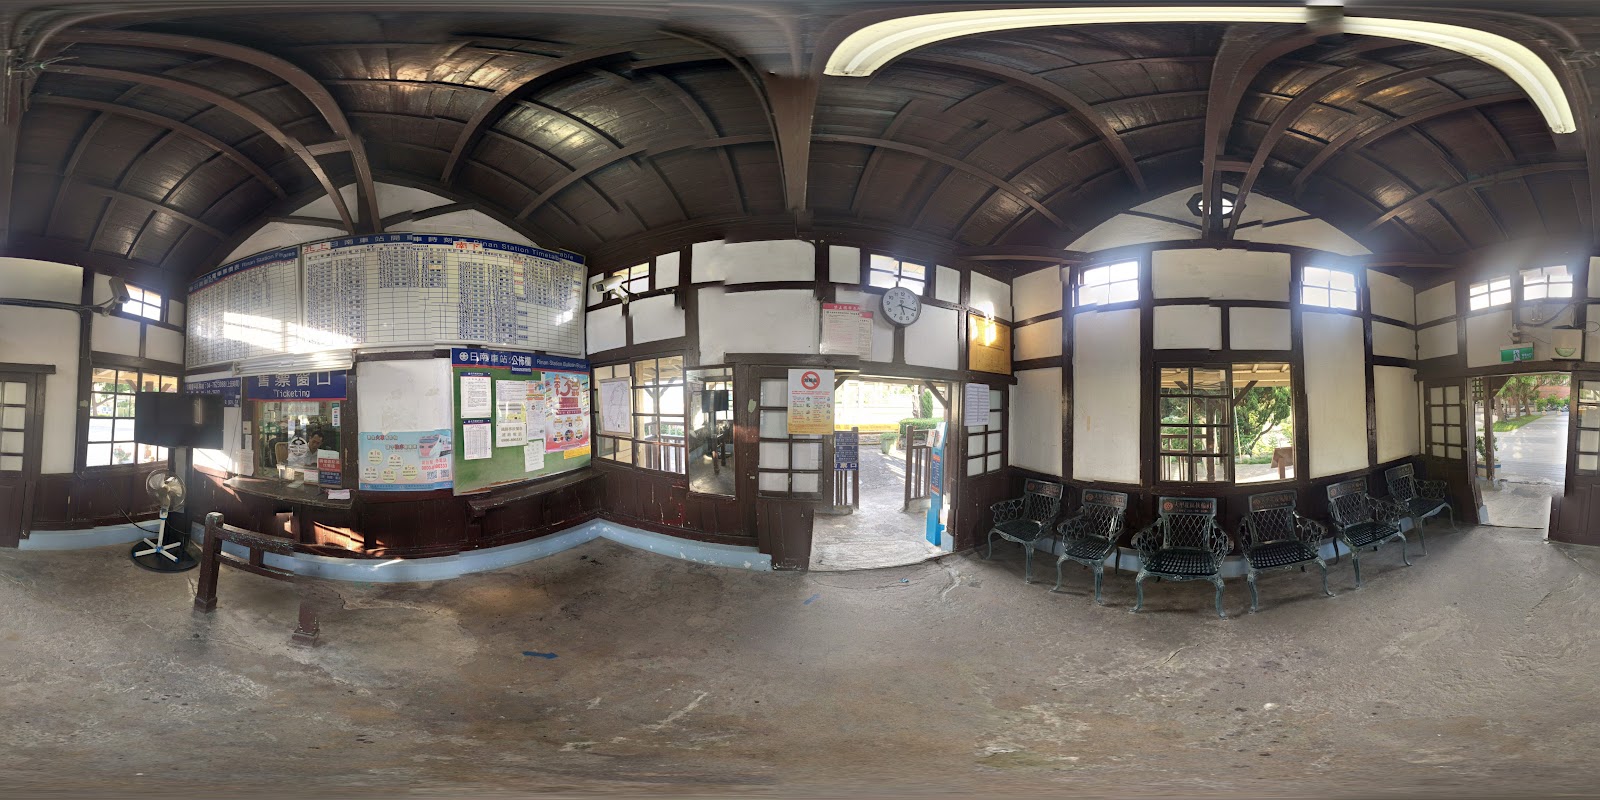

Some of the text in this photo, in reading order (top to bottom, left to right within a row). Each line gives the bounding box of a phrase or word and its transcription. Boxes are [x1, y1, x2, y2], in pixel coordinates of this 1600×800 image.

[501, 244, 530, 254] Station
[257, 372, 331, 388] 售票窗口
[275, 389, 311, 398] Ticketing
